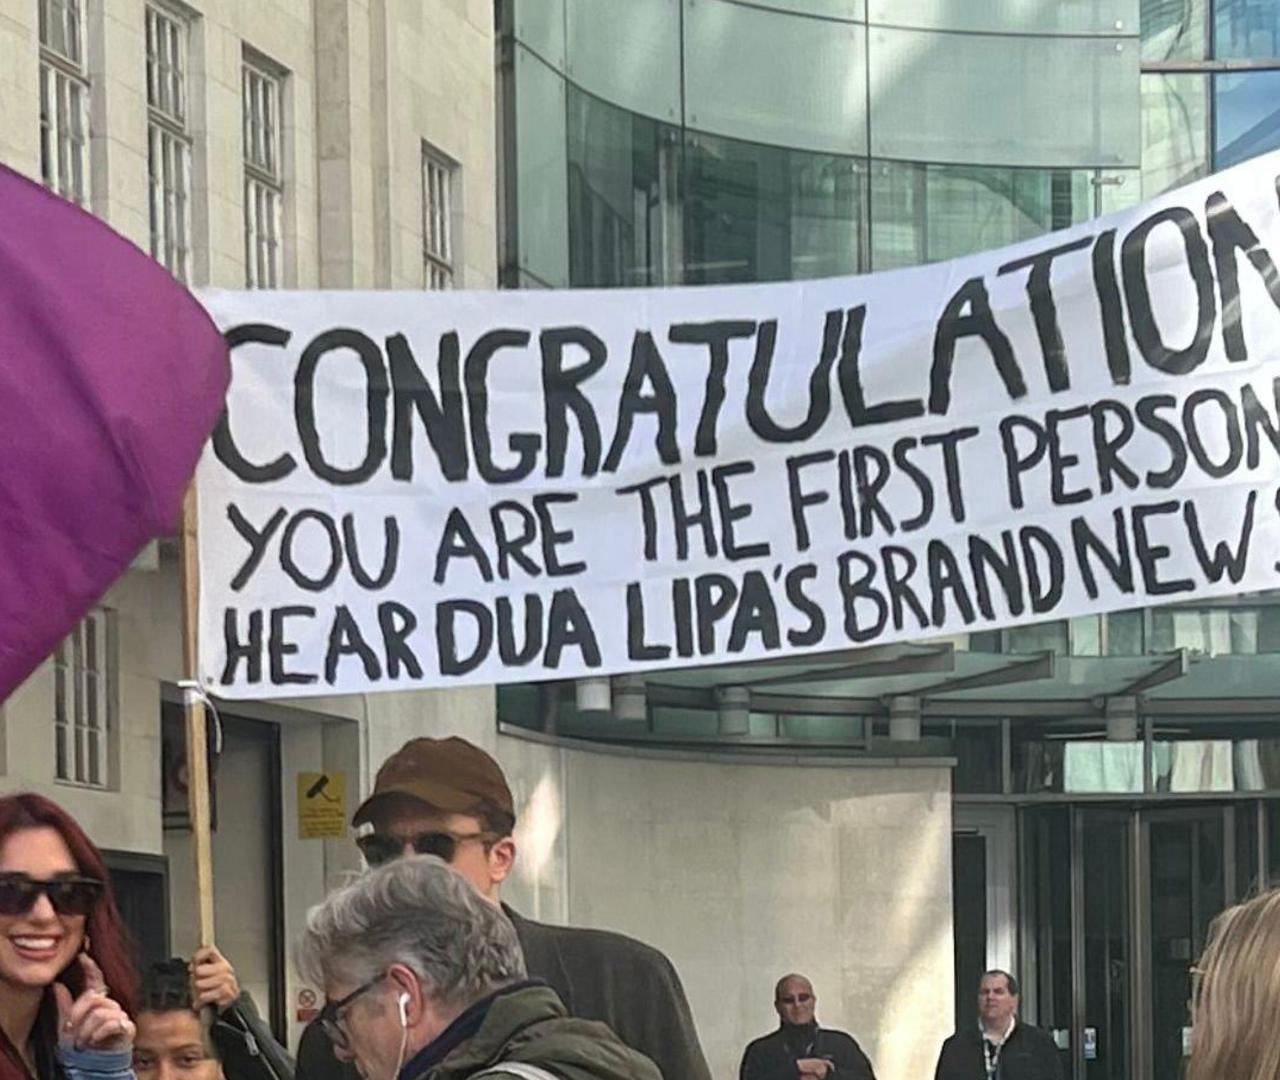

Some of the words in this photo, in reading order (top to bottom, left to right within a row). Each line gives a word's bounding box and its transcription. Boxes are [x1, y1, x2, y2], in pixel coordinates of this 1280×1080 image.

[220, 602, 423, 685] HEAR
[435, 587, 601, 676] DUA
[627, 563, 826, 661] LIPA'S
[838, 524, 1064, 642] BRAND
[1074, 489, 1257, 599] NEW
[227, 502, 399, 591] YOU
[433, 492, 586, 584] ARE
[616, 462, 770, 561] THE
[786, 426, 979, 550] FIRST
